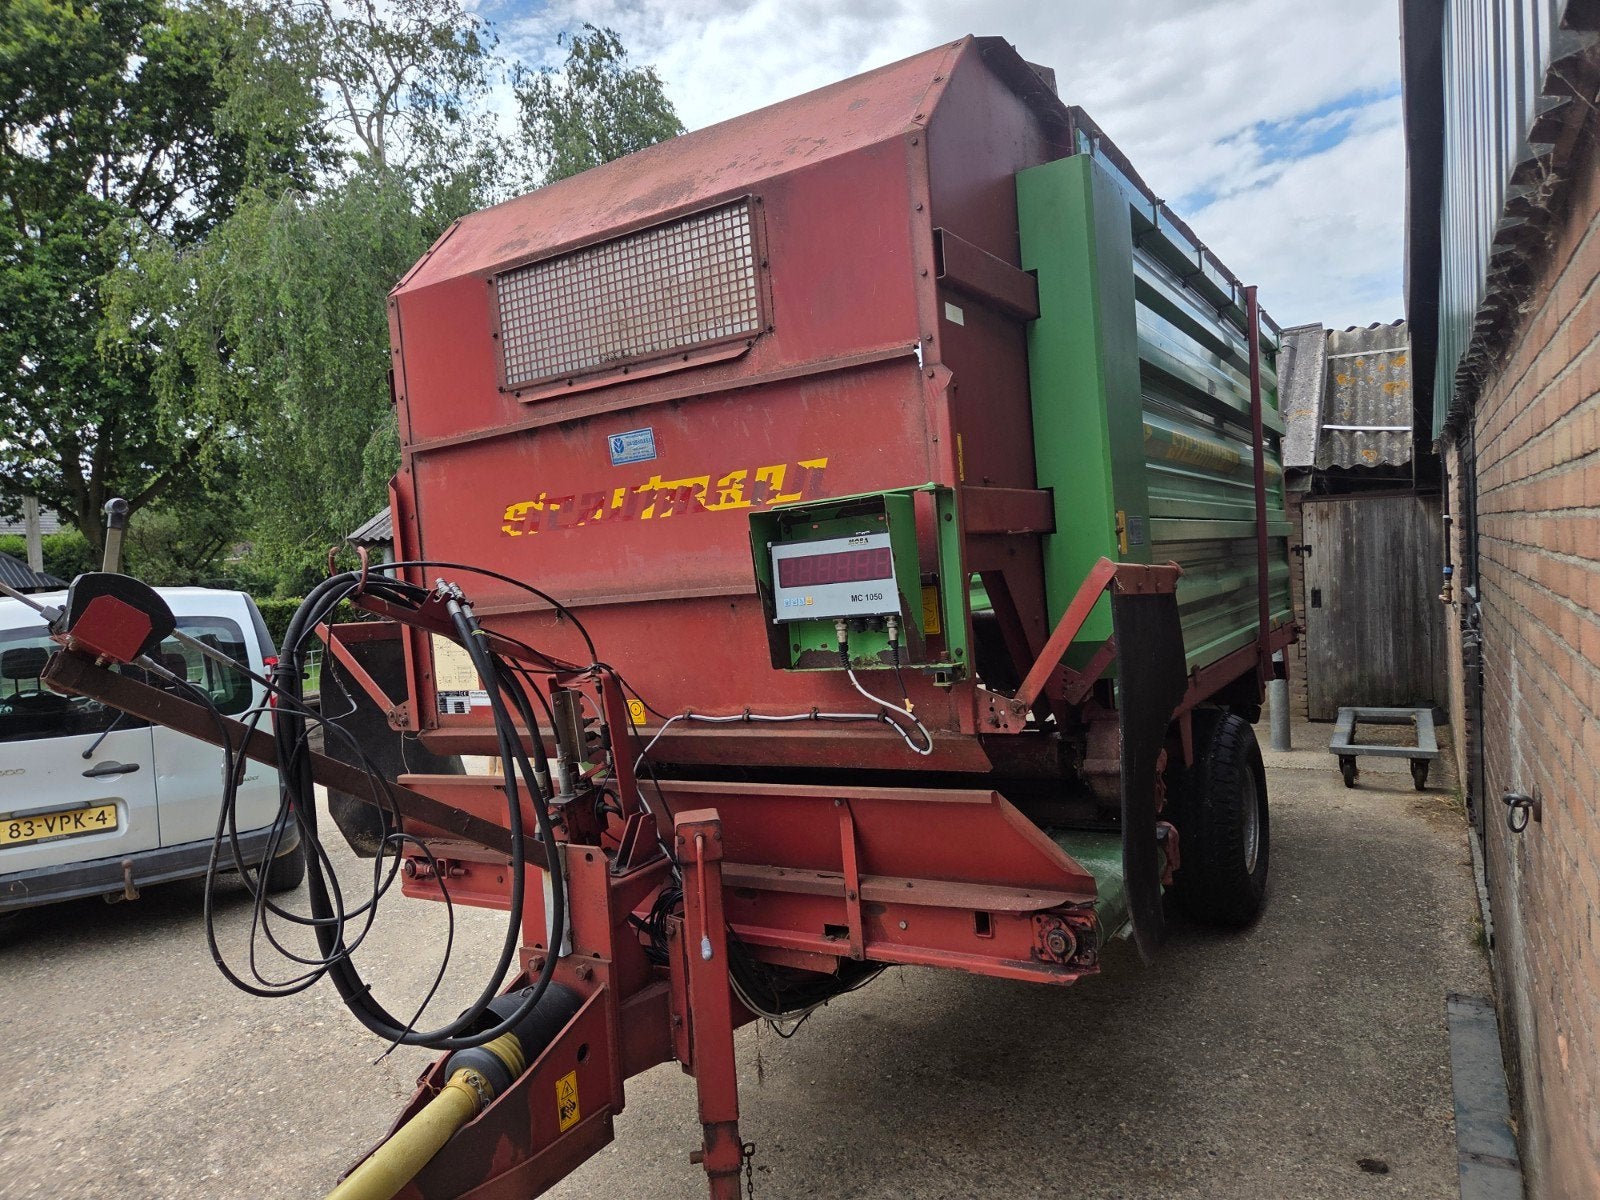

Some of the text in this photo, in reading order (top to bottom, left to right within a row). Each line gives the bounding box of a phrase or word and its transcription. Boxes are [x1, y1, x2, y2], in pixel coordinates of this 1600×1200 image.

[851, 592, 883, 603] MC 1050
[8, 809, 108, 839] 83-VPK-4
